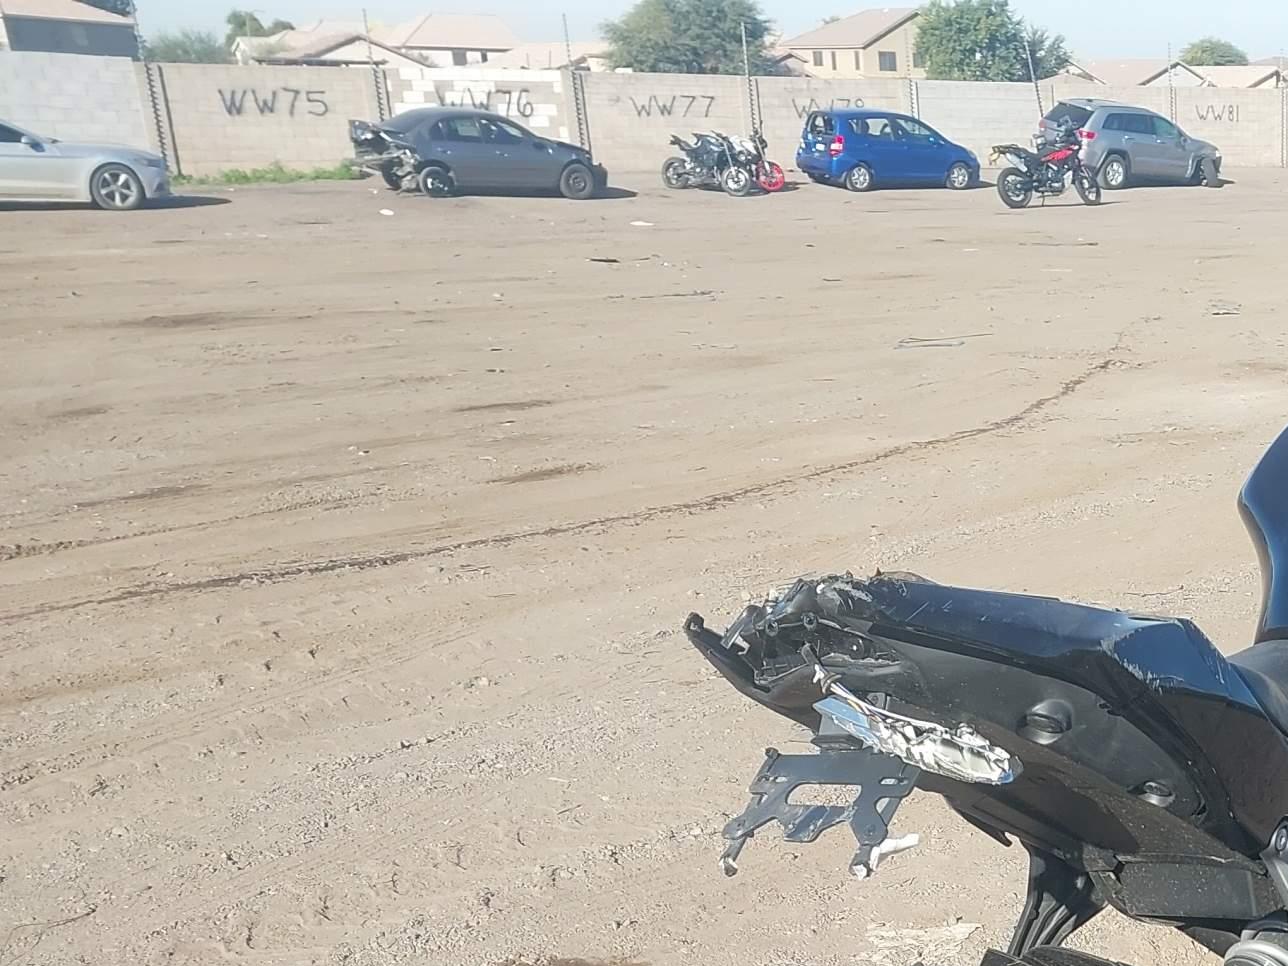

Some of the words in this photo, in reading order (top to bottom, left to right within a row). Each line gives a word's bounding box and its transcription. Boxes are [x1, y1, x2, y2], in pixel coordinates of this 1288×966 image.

[218, 87, 329, 117] WW75
[629, 95, 716, 118] WW77
[1195, 104, 1239, 122] WW81
